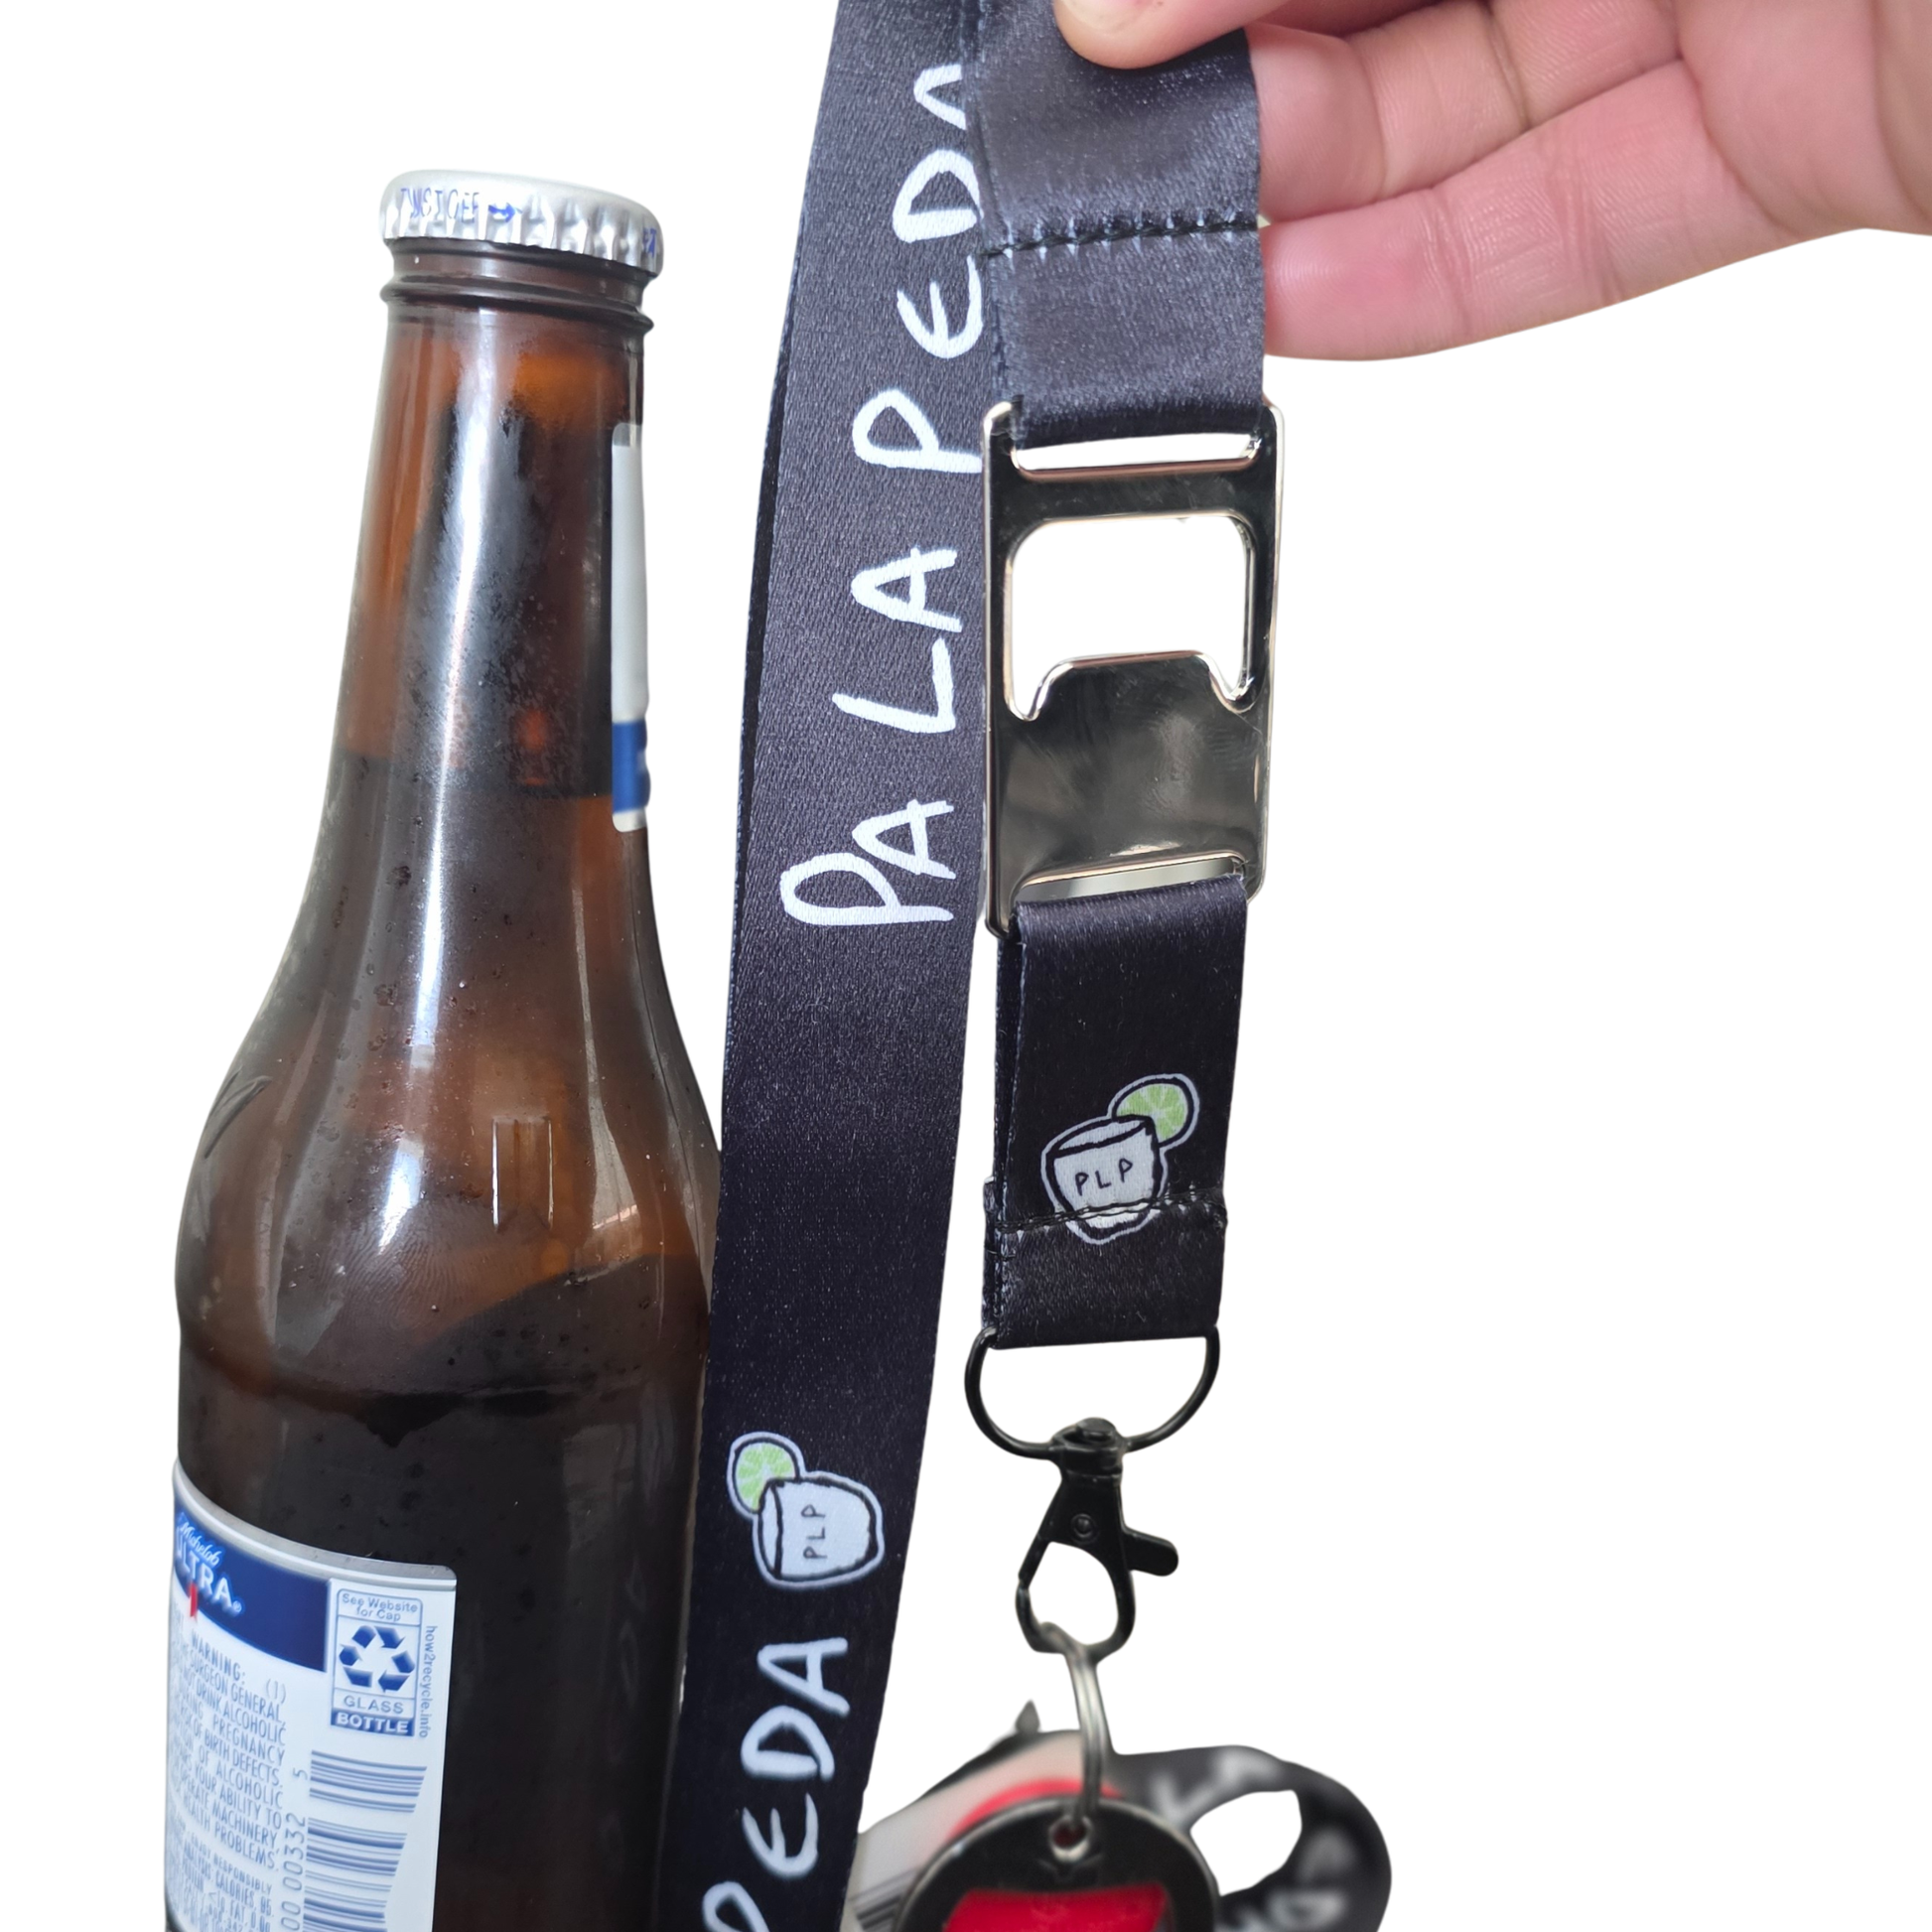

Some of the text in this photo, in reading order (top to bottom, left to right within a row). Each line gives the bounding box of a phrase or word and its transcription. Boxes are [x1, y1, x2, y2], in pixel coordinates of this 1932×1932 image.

[831, 545, 963, 734] LA
[780, 799, 956, 926] PA
[1074, 1158, 1133, 1196] PLP
[343, 1592, 418, 1613] See Website
[355, 1603, 401, 1622] for Cap
[191, 1628, 245, 1685] WARNING:
[418, 1625, 438, 1738] how2recycle.info
[223, 1695, 285, 1747] ALCOHOLIC
[337, 1712, 409, 1733] BOTTLE
[344, 1696, 404, 1715] GLASS
[212, 1710, 284, 1770] PREGNANCY
[215, 1753, 282, 1811] ALCOHOLIC
[219, 1780, 260, 1822] ABILITY
[267, 1807, 281, 1830] TO
[283, 1812, 306, 1891] 00332
